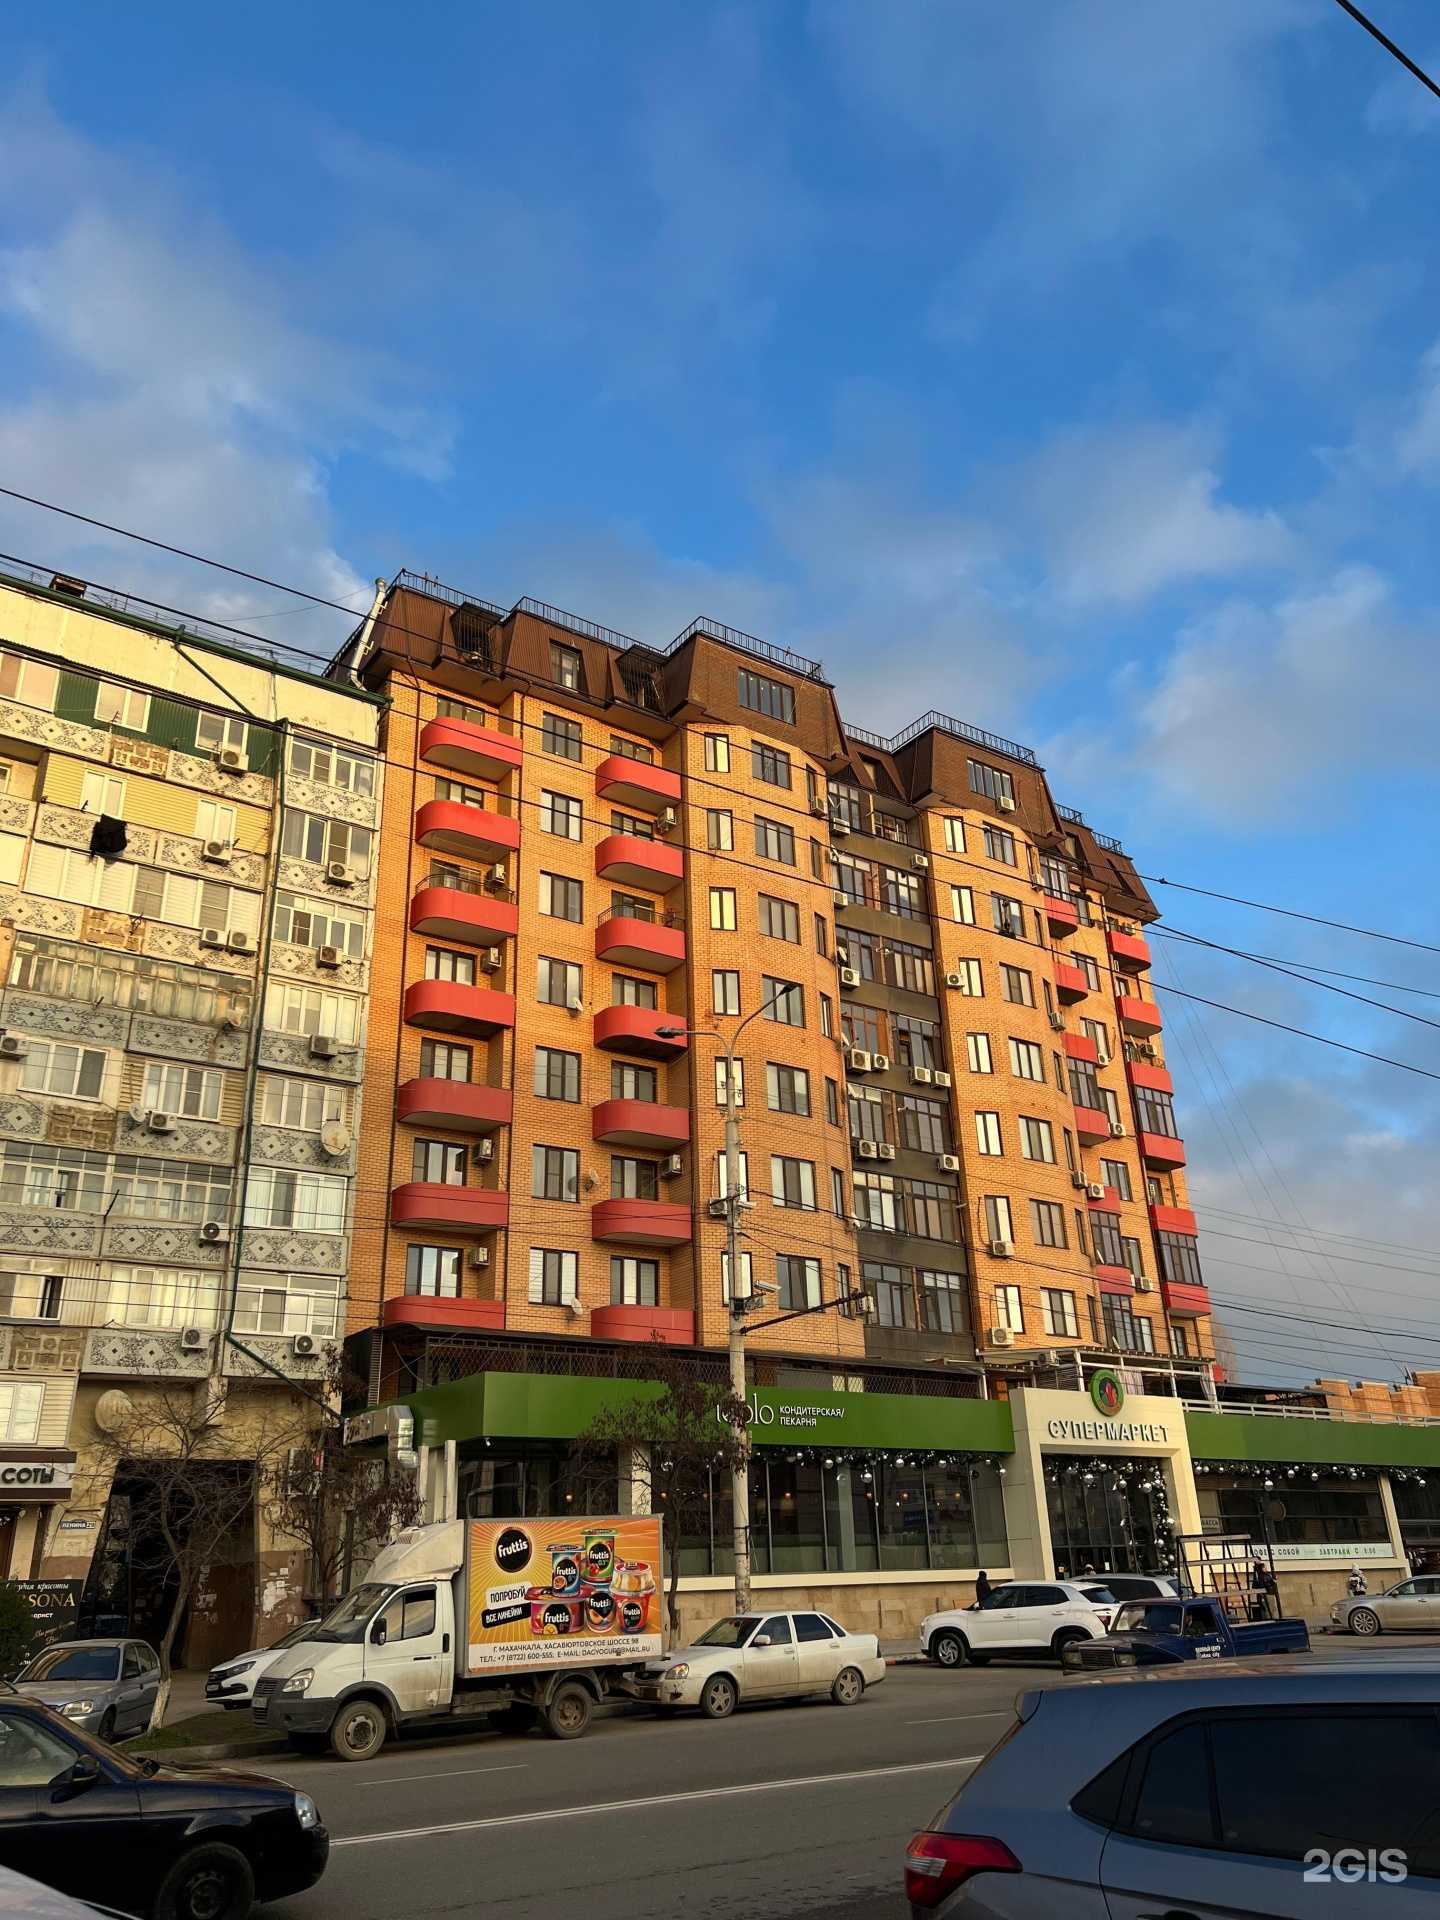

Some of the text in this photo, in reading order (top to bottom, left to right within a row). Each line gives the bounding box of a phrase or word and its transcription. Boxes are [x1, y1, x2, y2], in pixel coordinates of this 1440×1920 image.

[779, 1405, 845, 1419] КОНДИТЕРСКАЯ/
[780, 1417, 817, 1427] ПЕКАРНЯ
[1048, 1420, 1169, 1443] СУПЕРМАРКЕТ
[1, 1467, 55, 1484] СОТЫ
[497, 1538, 529, 1558] fruttis
[490, 1585, 526, 1604] ПОПРОБУЙ
[485, 1614, 498, 1624] ВСЕ
[499, 1643, 542, 1652] МАХАЧКАЛА,
[544, 1639, 606, 1650] ХАСАВЮРТОВСКОЕ
[607, 1638, 630, 1646] ШОССЕ
